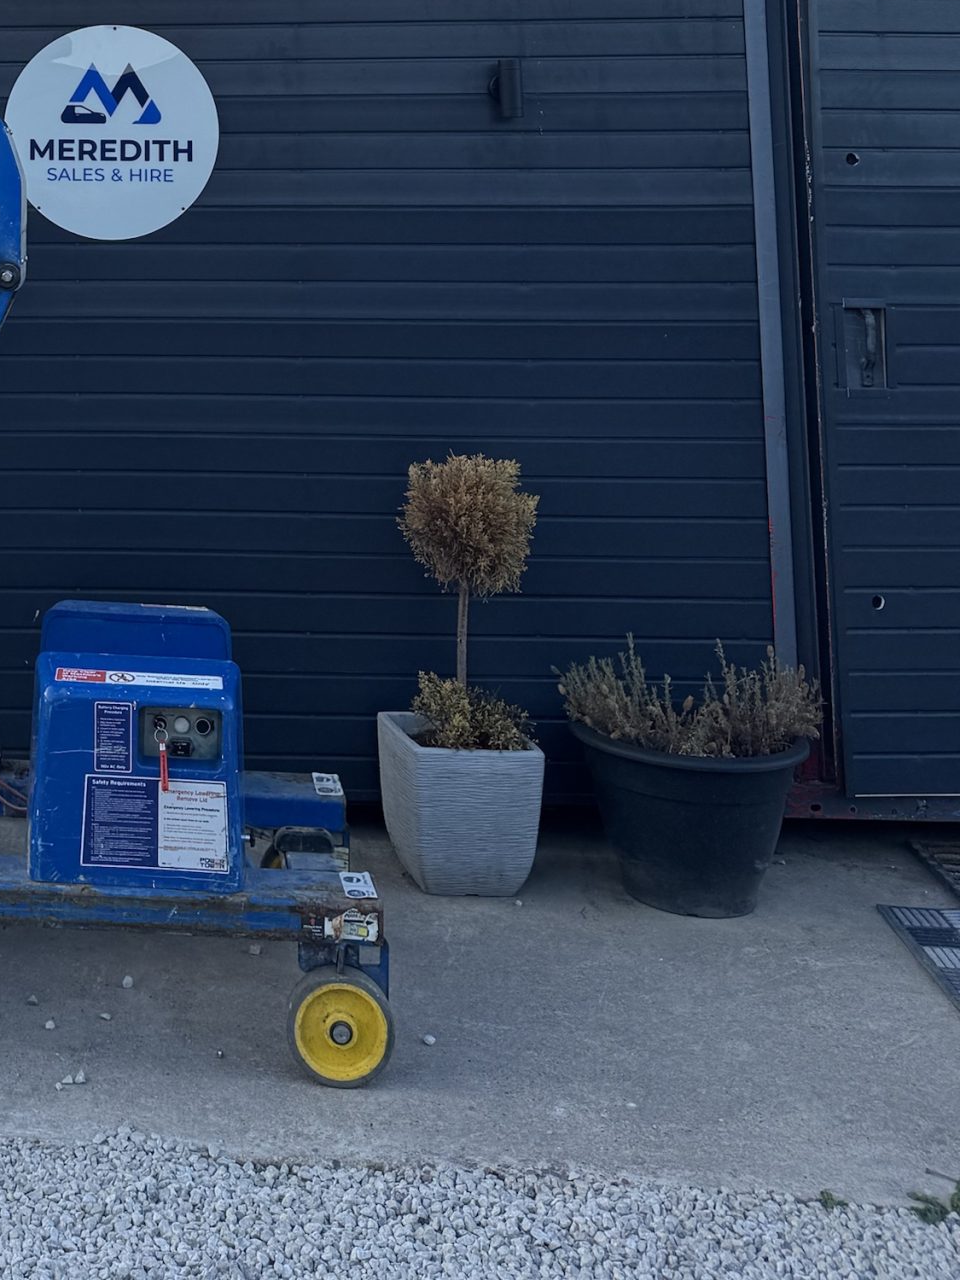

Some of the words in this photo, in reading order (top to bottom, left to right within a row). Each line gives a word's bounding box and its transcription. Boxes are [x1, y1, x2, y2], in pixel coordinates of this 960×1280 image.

[29, 138, 194, 162] MEREDITH
[46, 167, 105, 182] SALES
[111, 168, 123, 182] &
[129, 169, 174, 183] HIRE
